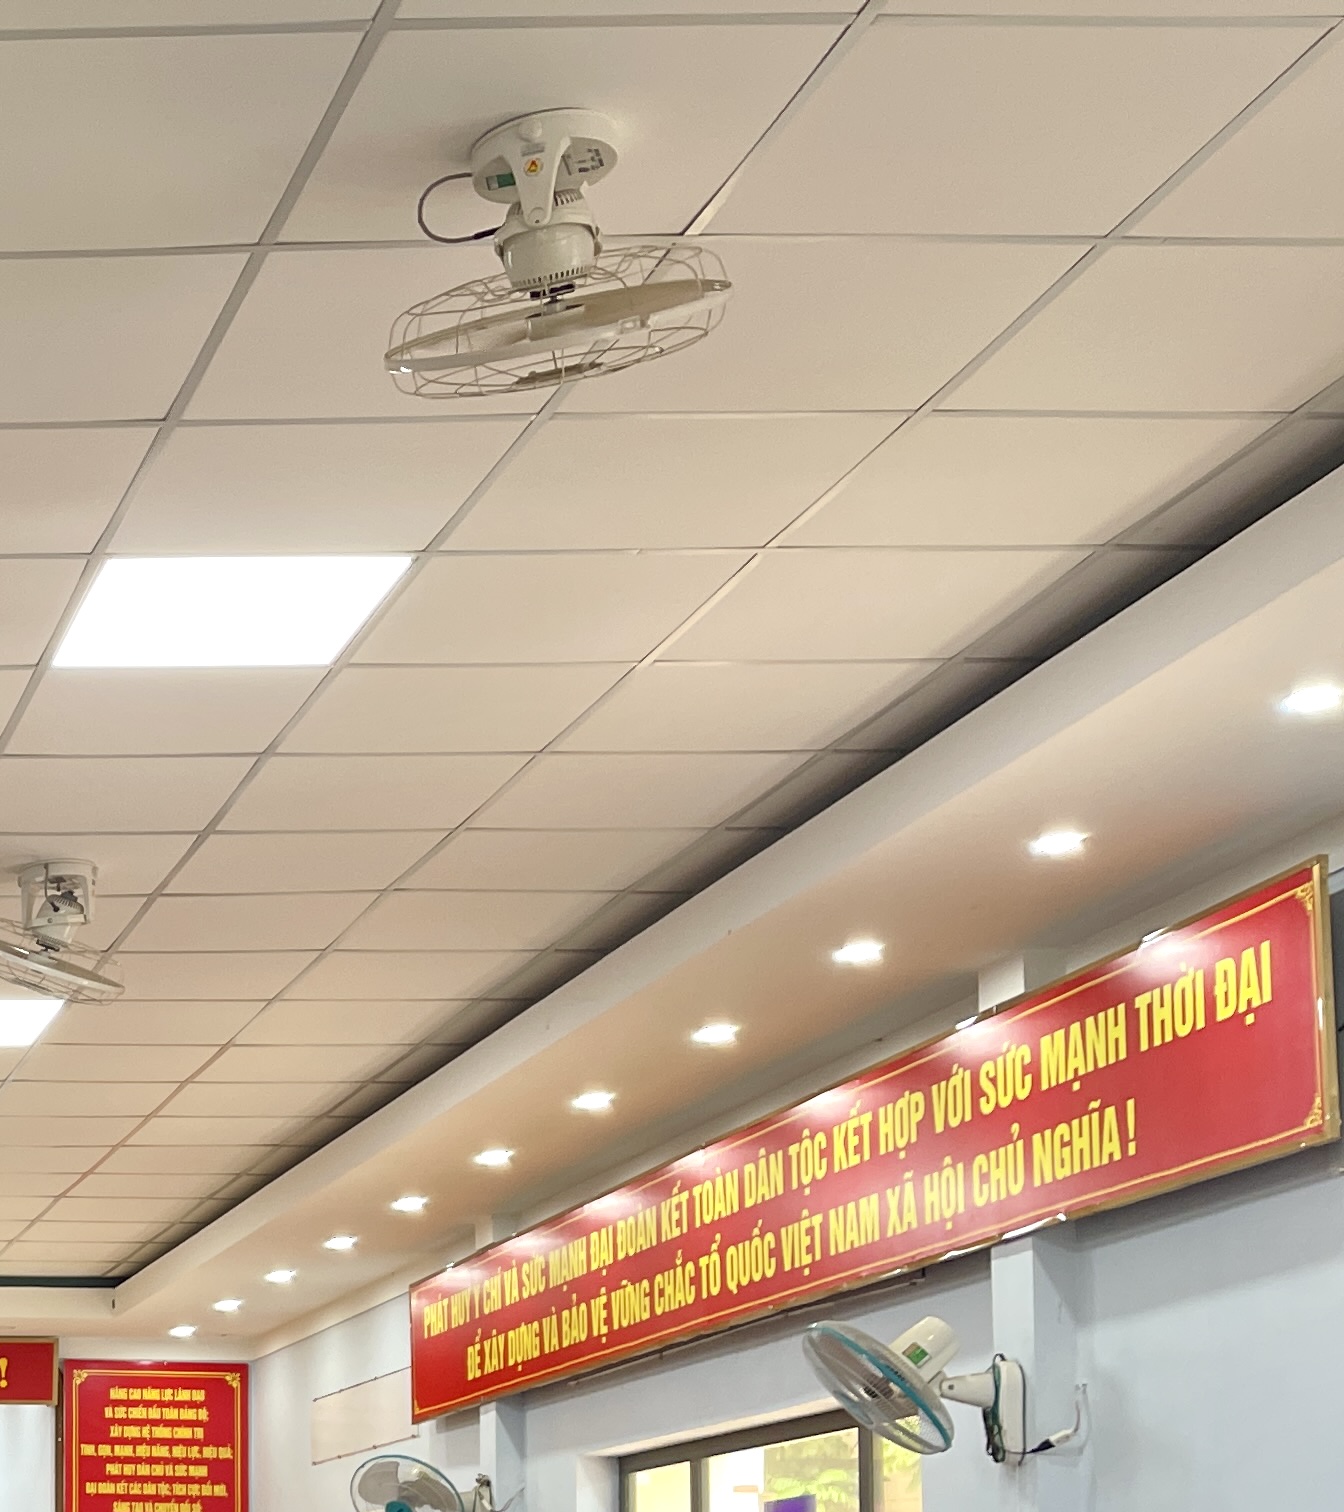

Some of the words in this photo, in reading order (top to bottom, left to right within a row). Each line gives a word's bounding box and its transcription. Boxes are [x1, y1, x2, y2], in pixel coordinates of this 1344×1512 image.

[467, 1328, 481, 1380] ĐỂ
[483, 1329, 504, 1373] XÂY
[542, 1306, 559, 1353] VÀ
[561, 1293, 587, 1347] BẢO
[590, 1286, 608, 1343] VỆ
[653, 1249, 695, 1315] CHẮC
[698, 1233, 721, 1299] TỔ
[725, 1219, 776, 1294] QUỐC
[779, 1208, 824, 1276] VIỆT
[827, 1193, 881, 1256] NAM
[885, 1171, 918, 1237] XÃ
[923, 1155, 965, 1230] HỘI
[971, 1122, 1025, 1207] CHỦ
[1031, 1099, 1122, 1187] NGHĨA
[504, 1260, 520, 1306] VÀ
[548, 1236, 587, 1292] MẠNH
[589, 1226, 614, 1276] ĐẠI
[658, 1180, 689, 1242] KẾT
[691, 1167, 739, 1228] TOÀN
[742, 1147, 784, 1208] DÂN
[786, 1127, 827, 1195] TỘC
[831, 1100, 873, 1173] KẾT
[877, 1090, 925, 1159] HỢP
[930, 1063, 972, 1133] VỚI
[978, 1042, 1032, 1114] SỨC
[1038, 1002, 1126, 1091] MẠNH
[1134, 964, 1205, 1051] THỜI
[1213, 940, 1272, 1025] ĐẠI
